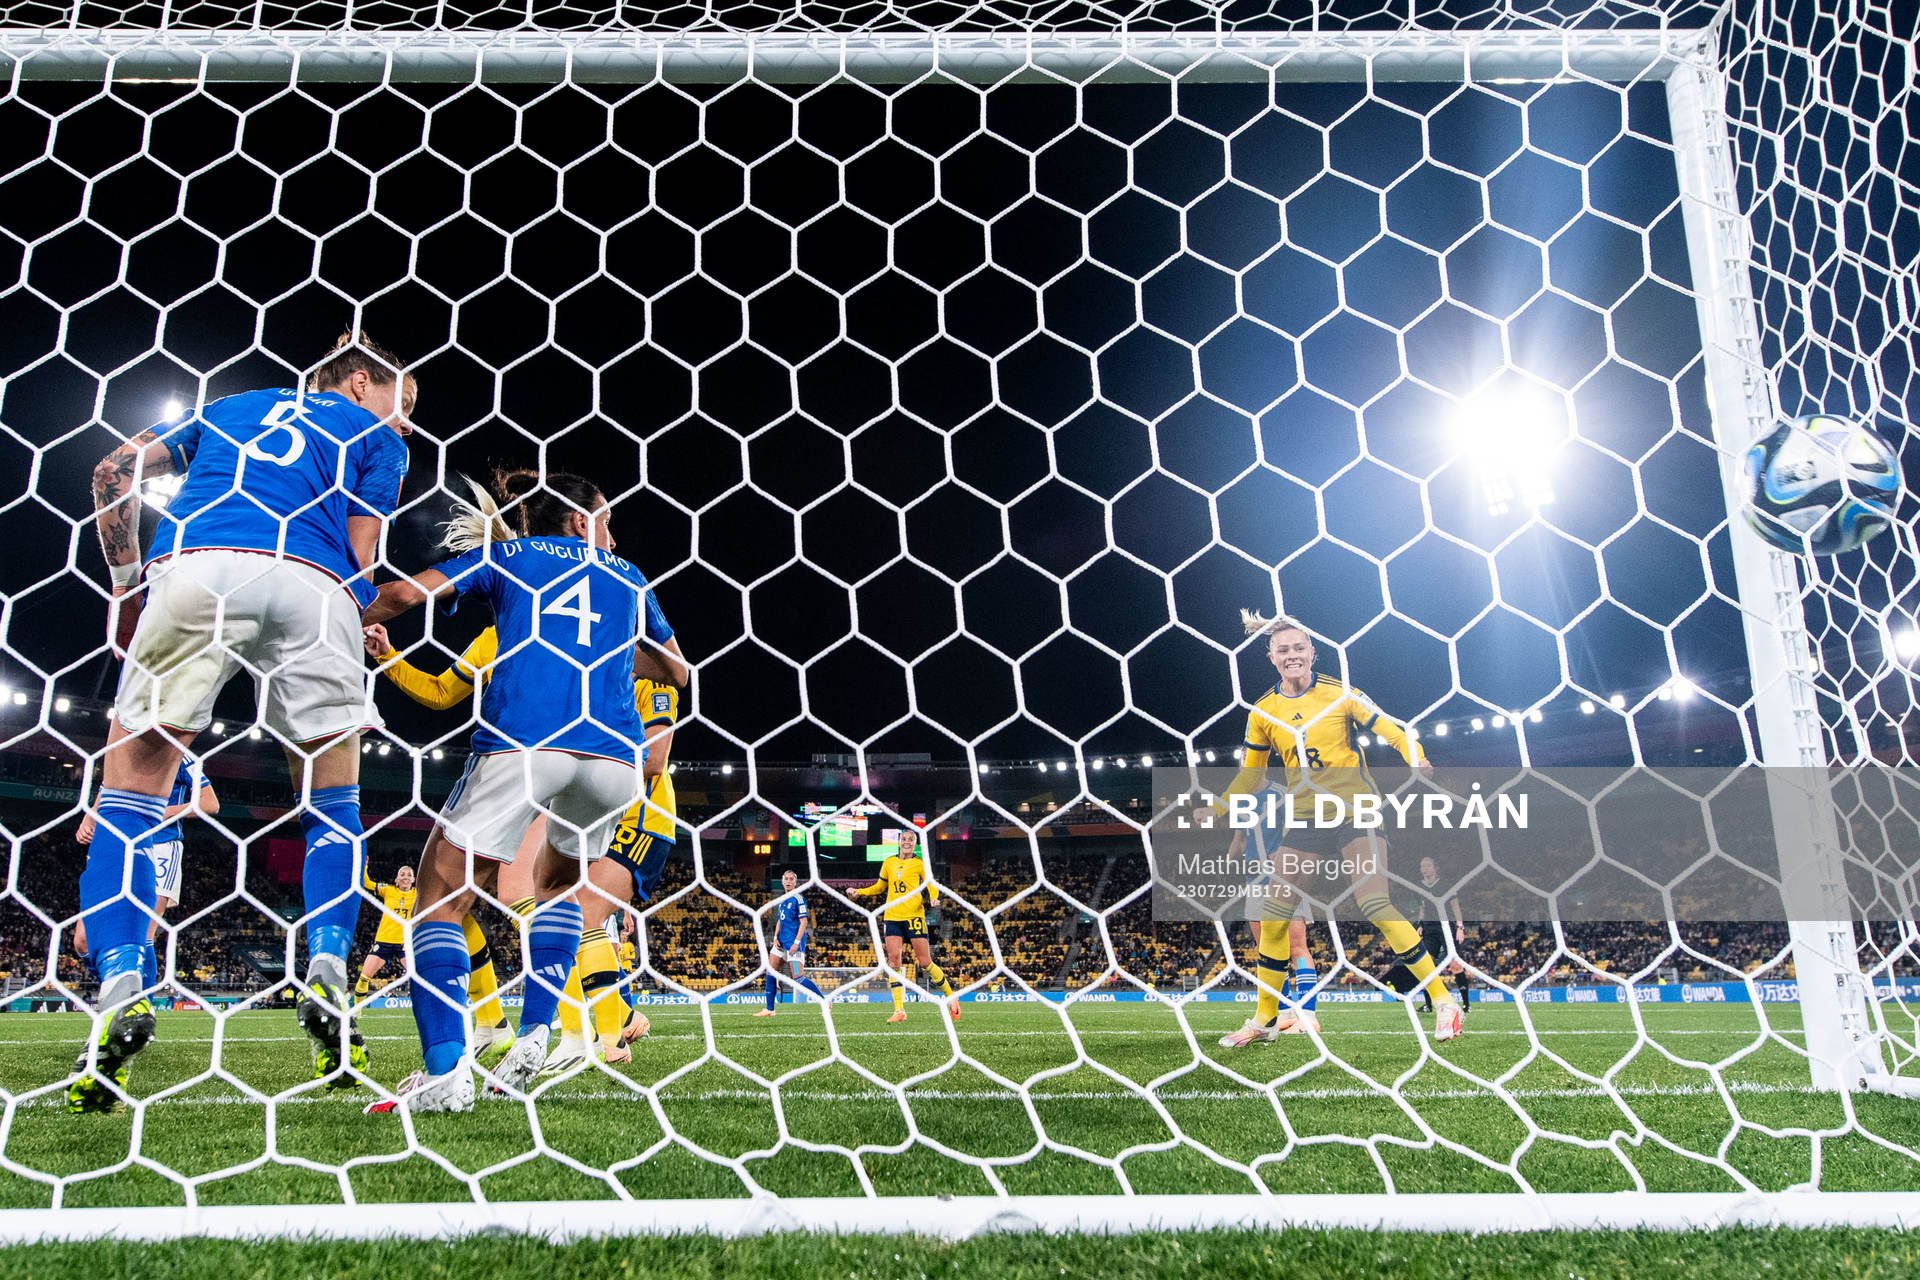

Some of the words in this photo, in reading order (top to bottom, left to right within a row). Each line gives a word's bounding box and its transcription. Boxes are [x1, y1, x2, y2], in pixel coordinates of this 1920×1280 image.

[246, 401, 312, 467] 5
[503, 541, 523, 557] DI
[541, 575, 602, 648] 4
[894, 881, 907, 893] 16
[908, 917, 923, 930] 16
[1079, 993, 1116, 1002] WANDA
[1574, 989, 1598, 1002] WANDA
[1691, 986, 1726, 1002] WANDA
